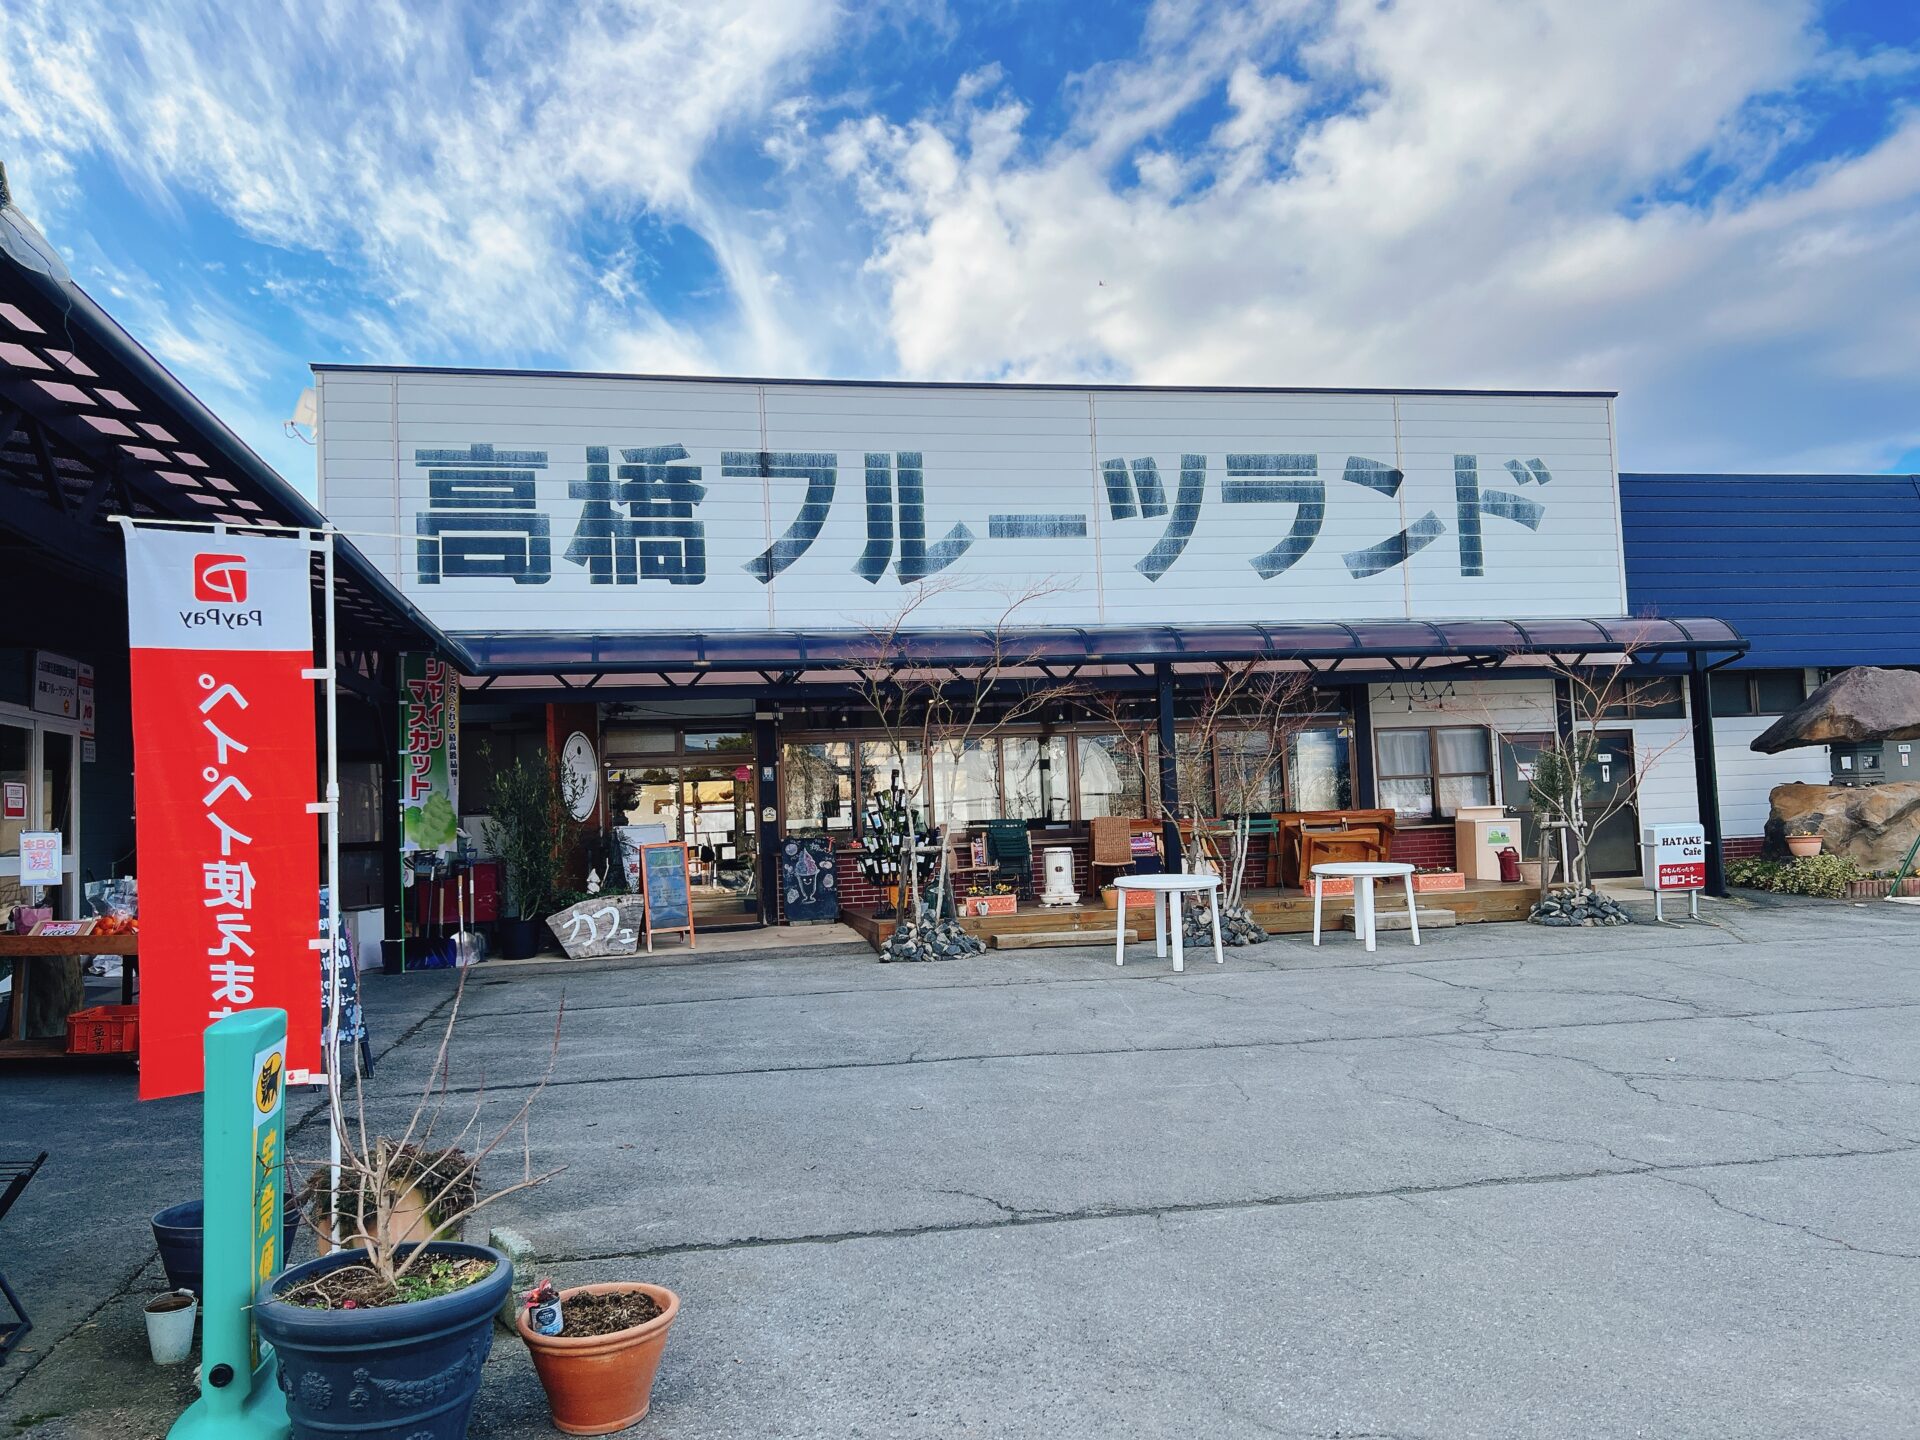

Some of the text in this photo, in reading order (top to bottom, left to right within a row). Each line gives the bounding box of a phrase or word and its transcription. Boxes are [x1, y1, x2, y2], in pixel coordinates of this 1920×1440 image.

[415, 442, 1552, 586] 高橋フルーツランド
[407, 679, 432, 800] マスカット
[426, 657, 445, 749] シャイン
[1662, 836, 1702, 846] HATAKE
[562, 906, 637, 947] カフェ
